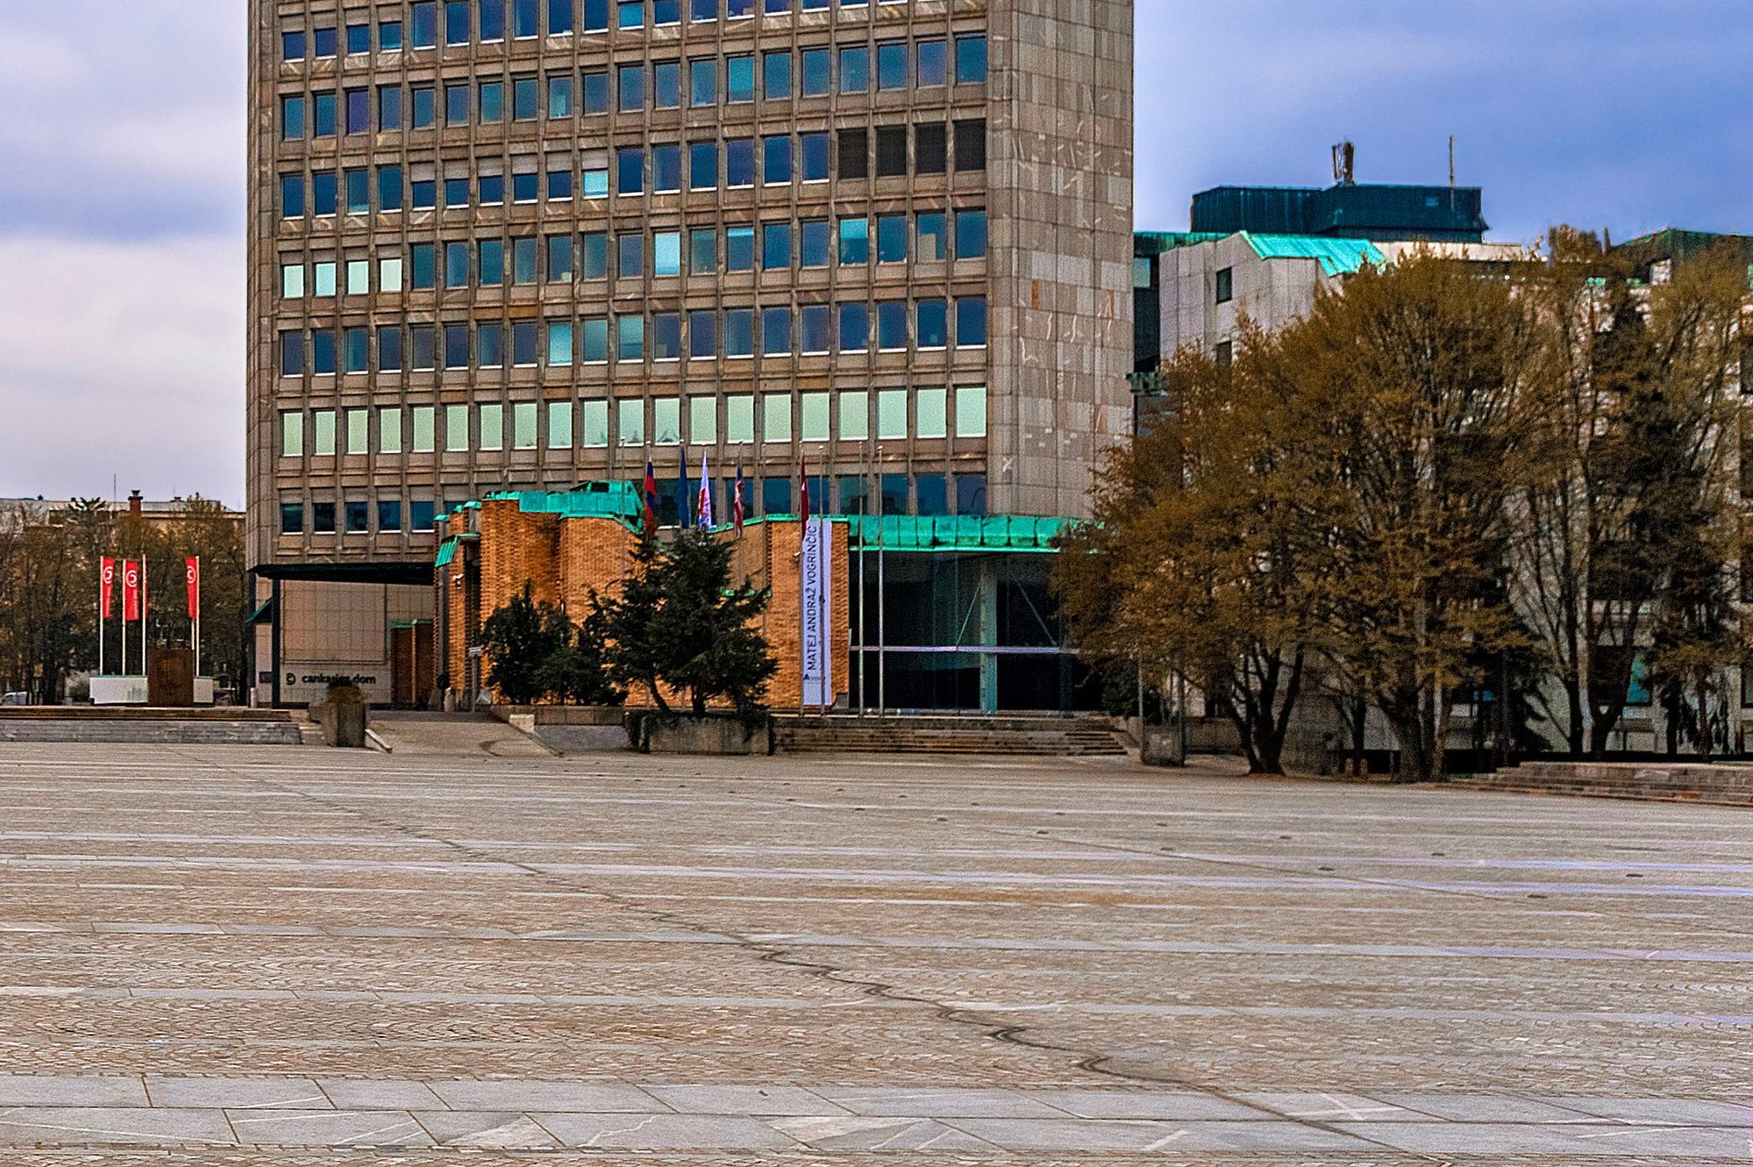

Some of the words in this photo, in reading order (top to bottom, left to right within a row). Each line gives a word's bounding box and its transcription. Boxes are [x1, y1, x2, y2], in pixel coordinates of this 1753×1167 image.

[805, 587, 817, 633] ANDRAŽ
[807, 635, 817, 671] MATEJ
[352, 673, 377, 685] dom
